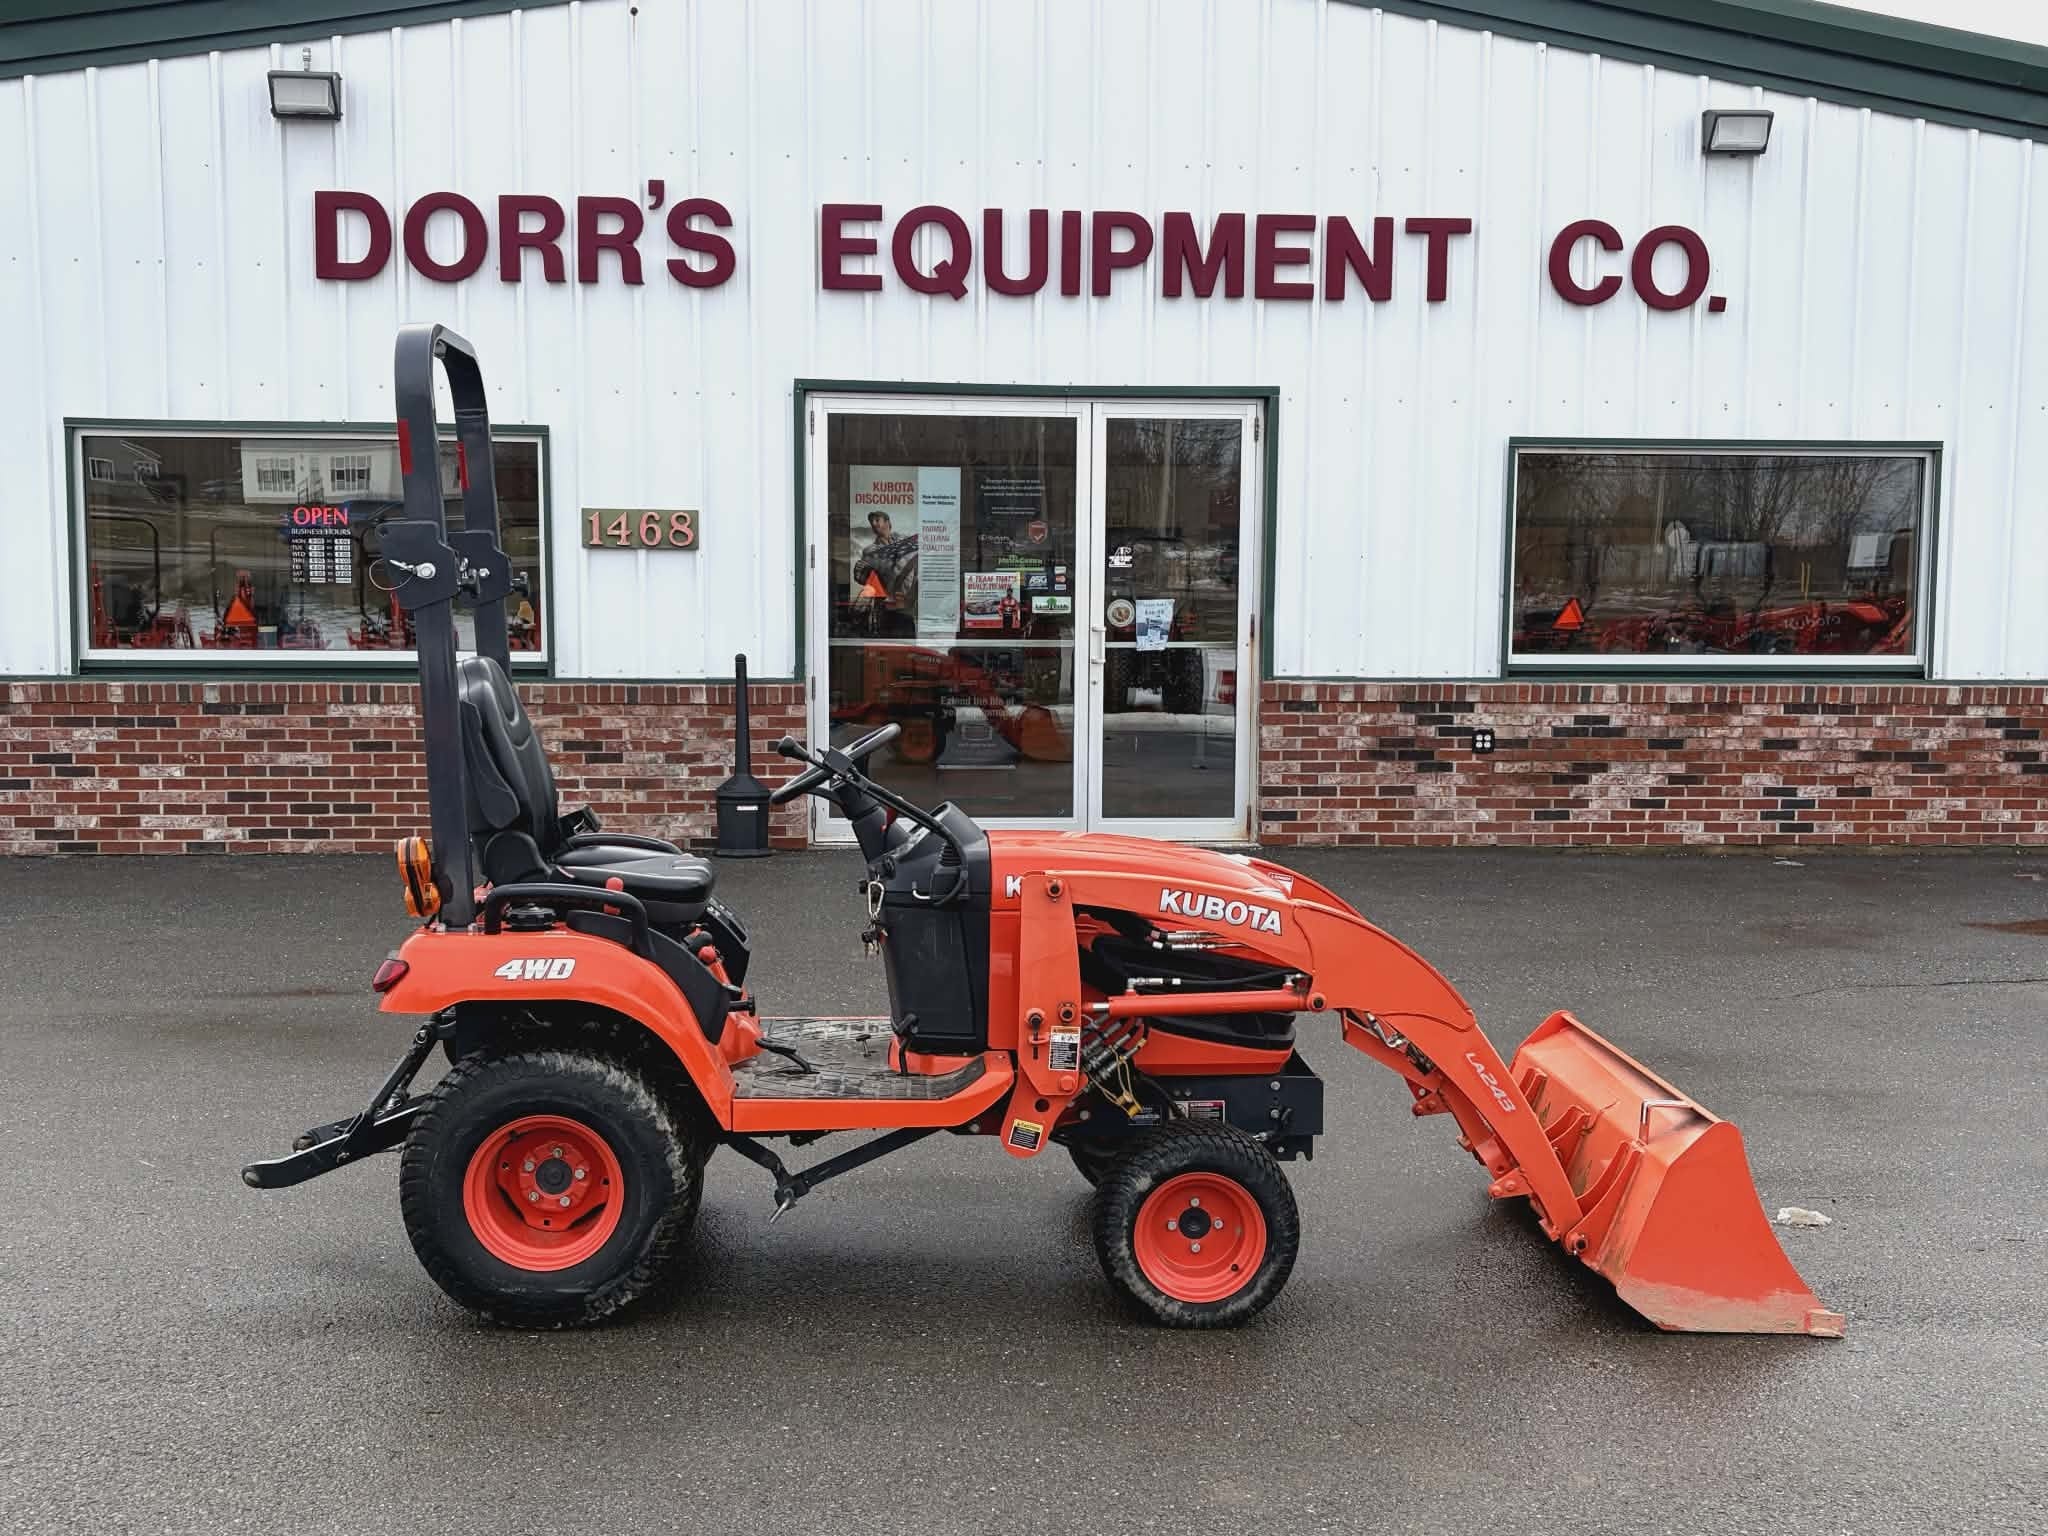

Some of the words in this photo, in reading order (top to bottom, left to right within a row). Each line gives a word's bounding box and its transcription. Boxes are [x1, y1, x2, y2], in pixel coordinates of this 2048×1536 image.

[315, 179, 736, 289] DORR'S
[822, 203, 1472, 302] EQUIPMENT
[1549, 219, 1727, 312] CO.
[872, 481, 914, 493] KUBOTA
[855, 493, 914, 505] DISCOUNTS
[293, 506, 349, 525] OPEN
[587, 511, 694, 547] 1468
[1784, 615, 1841, 630] Kubota
[1160, 888, 1283, 936] KUBOTA
[494, 958, 576, 980] 4WD
[1465, 1052, 1516, 1112] LA243
